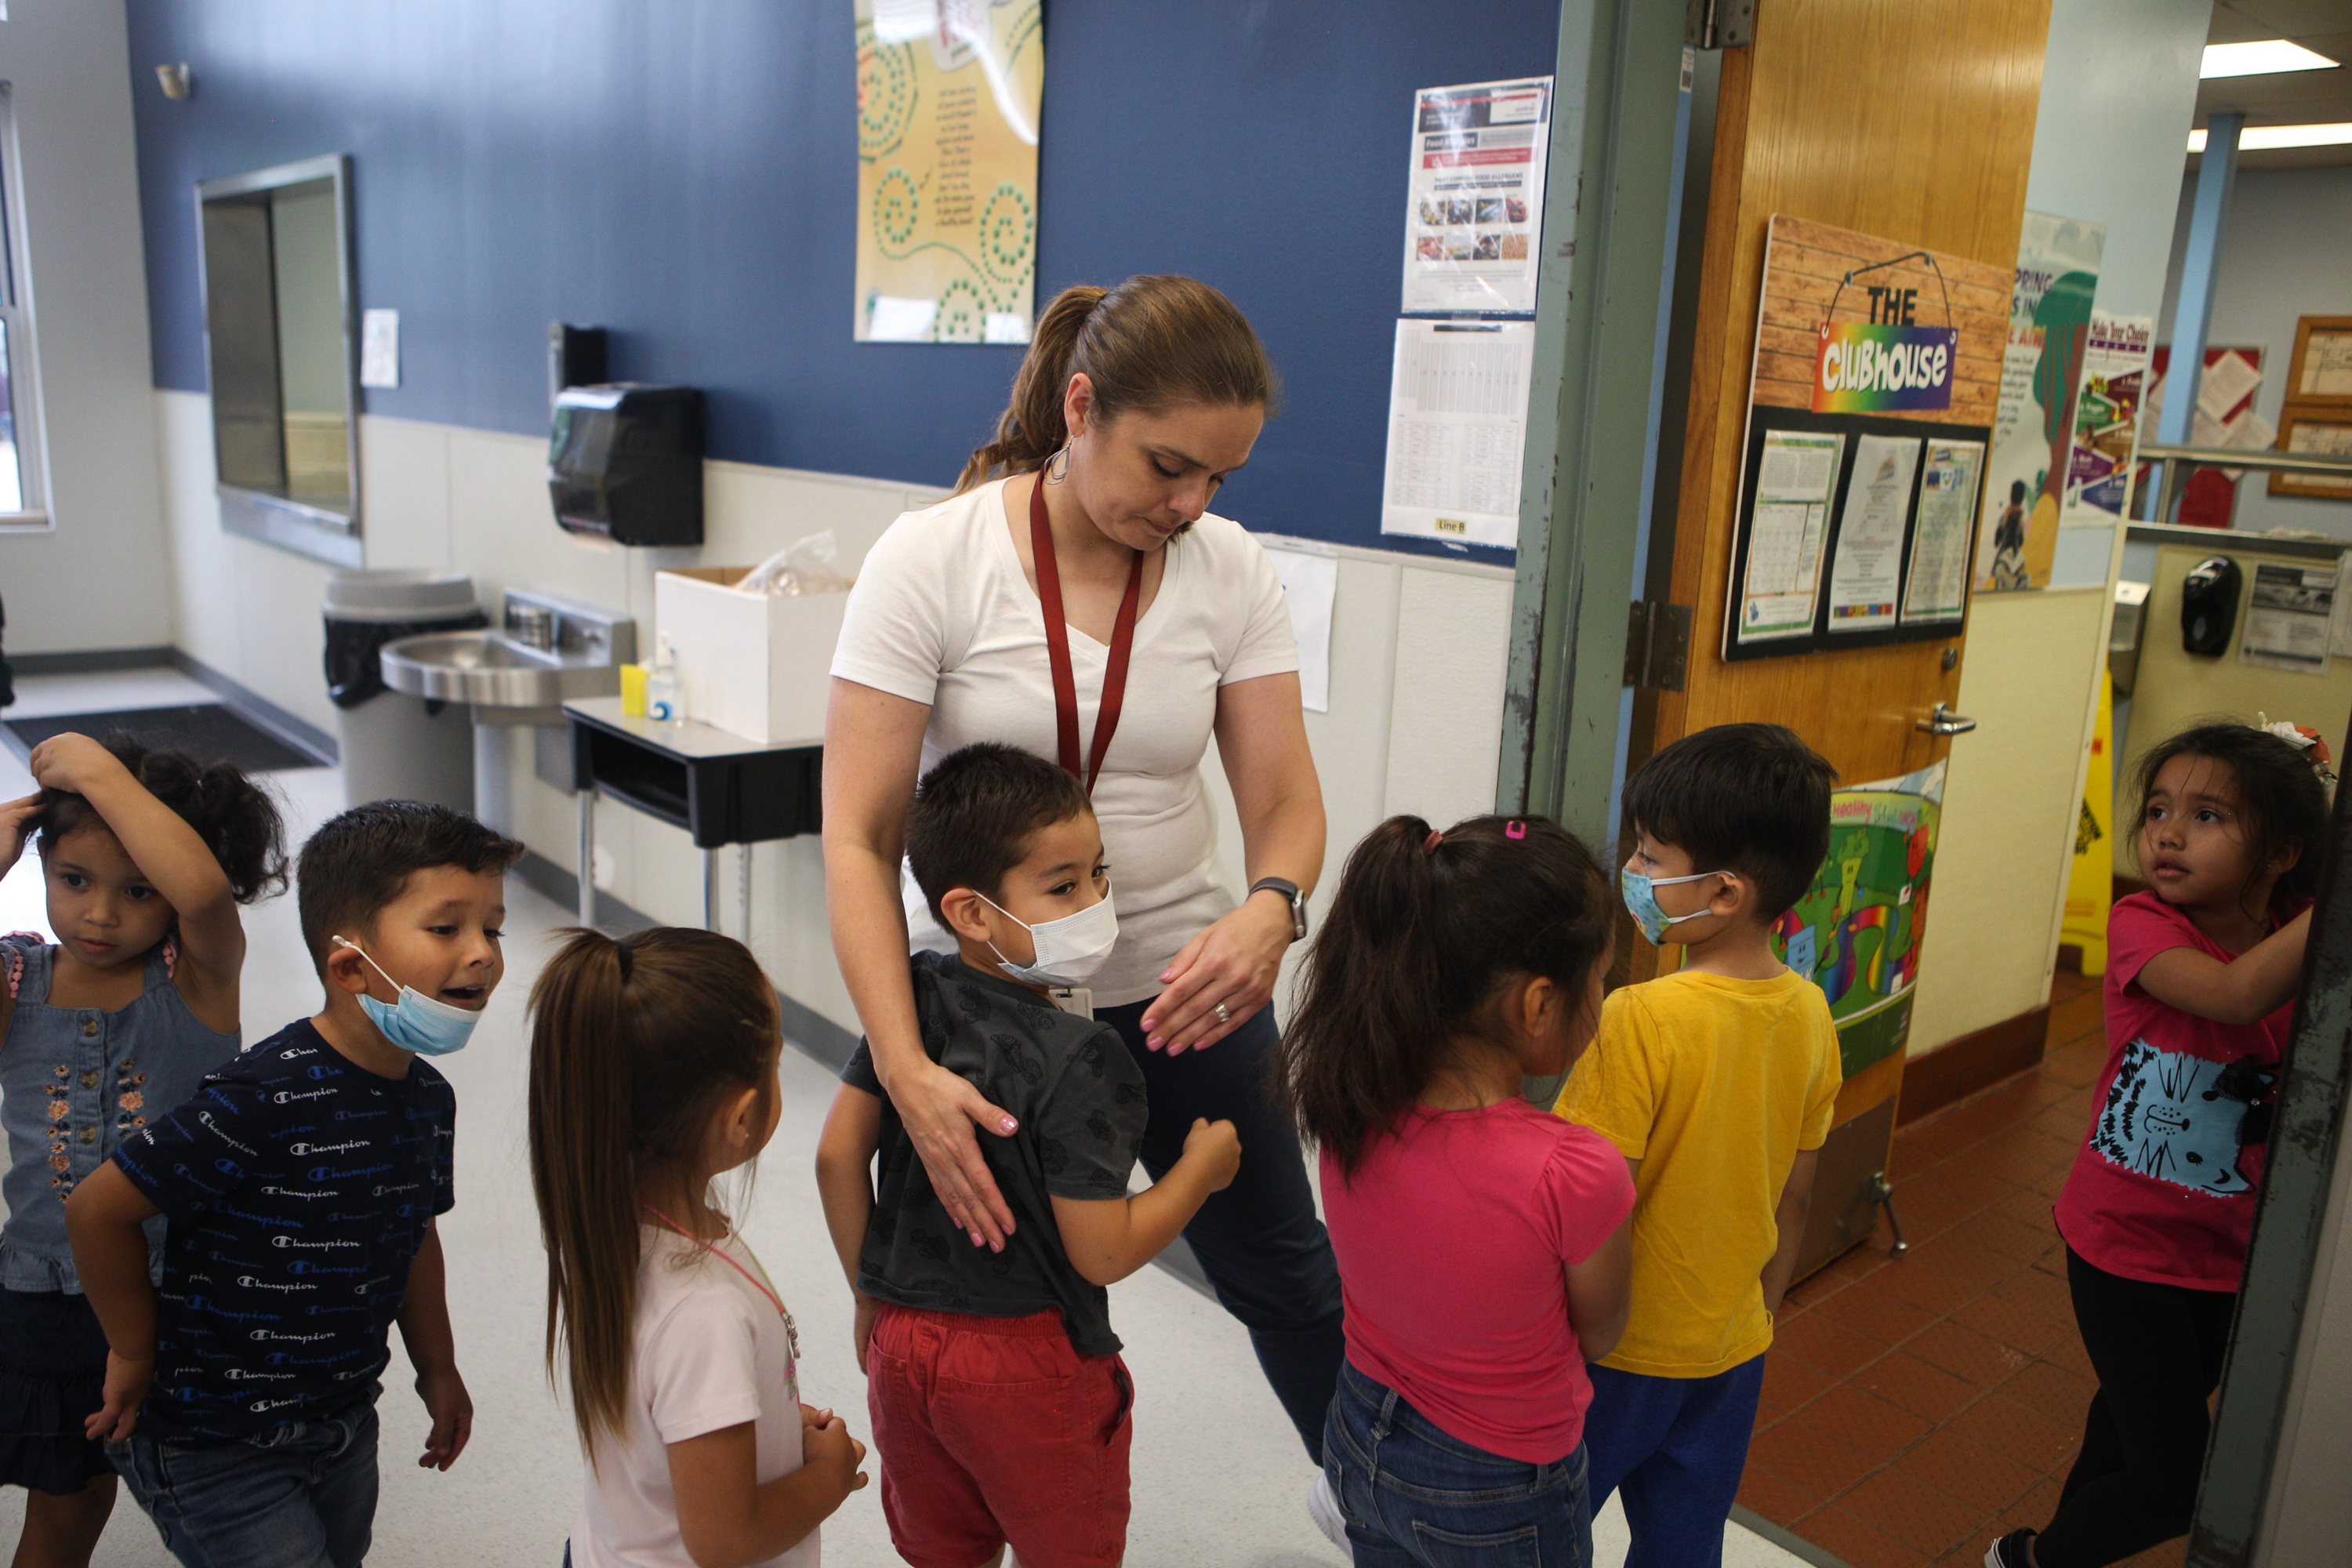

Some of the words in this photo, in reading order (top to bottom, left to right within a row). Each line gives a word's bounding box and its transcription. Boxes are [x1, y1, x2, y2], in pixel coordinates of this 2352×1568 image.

[2015, 269, 2053, 294] PRING
[1867, 286, 1918, 327] THE
[1439, 520, 1457, 531] Line
[1459, 522, 1465, 532] B
[274, 1087, 339, 1104] Champion
[198, 1111, 259, 1156] Champion
[289, 1140, 371, 1156] Champion
[307, 1163, 394, 1182] Champion
[261, 1186, 339, 1202] Champion
[372, 1182, 420, 1197] Champion
[212, 1200, 305, 1229] Champion
[272, 1236, 361, 1252] Champion
[209, 1250, 265, 1269] Champion
[237, 1276, 318, 1294] Champion
[184, 1294, 281, 1324] Champion
[249, 1329, 336, 1345] Champion
[265, 1348, 361, 1367] Champion
[224, 1368, 296, 1382] Champion
